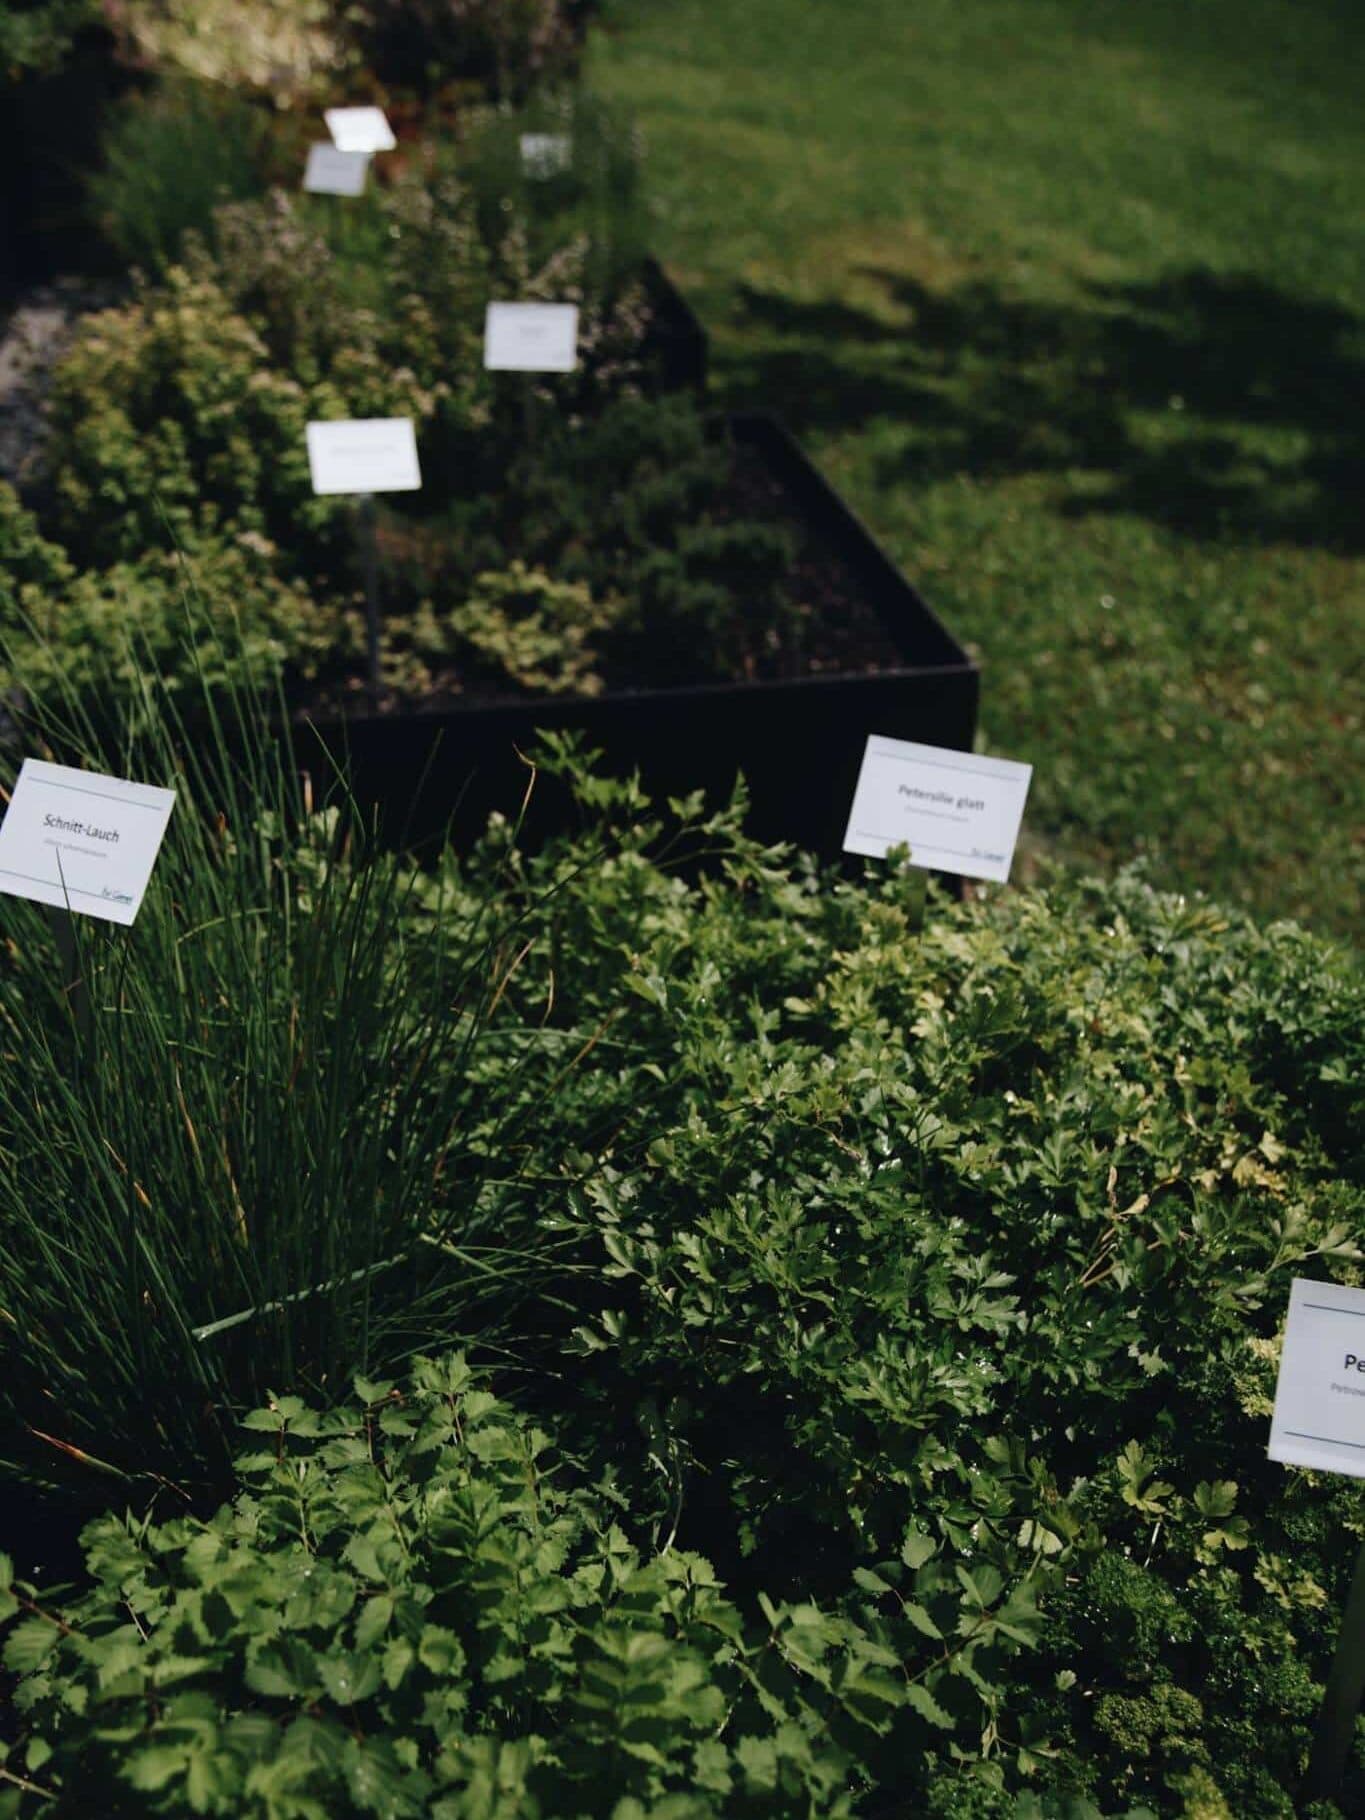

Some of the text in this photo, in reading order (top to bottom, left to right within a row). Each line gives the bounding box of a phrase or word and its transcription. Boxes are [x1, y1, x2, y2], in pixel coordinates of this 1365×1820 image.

[898, 783, 985, 811] Petersilie glatt
[43, 813, 120, 843] Schnitt-Lauch
[1344, 1353, 1365, 1374] Pe
